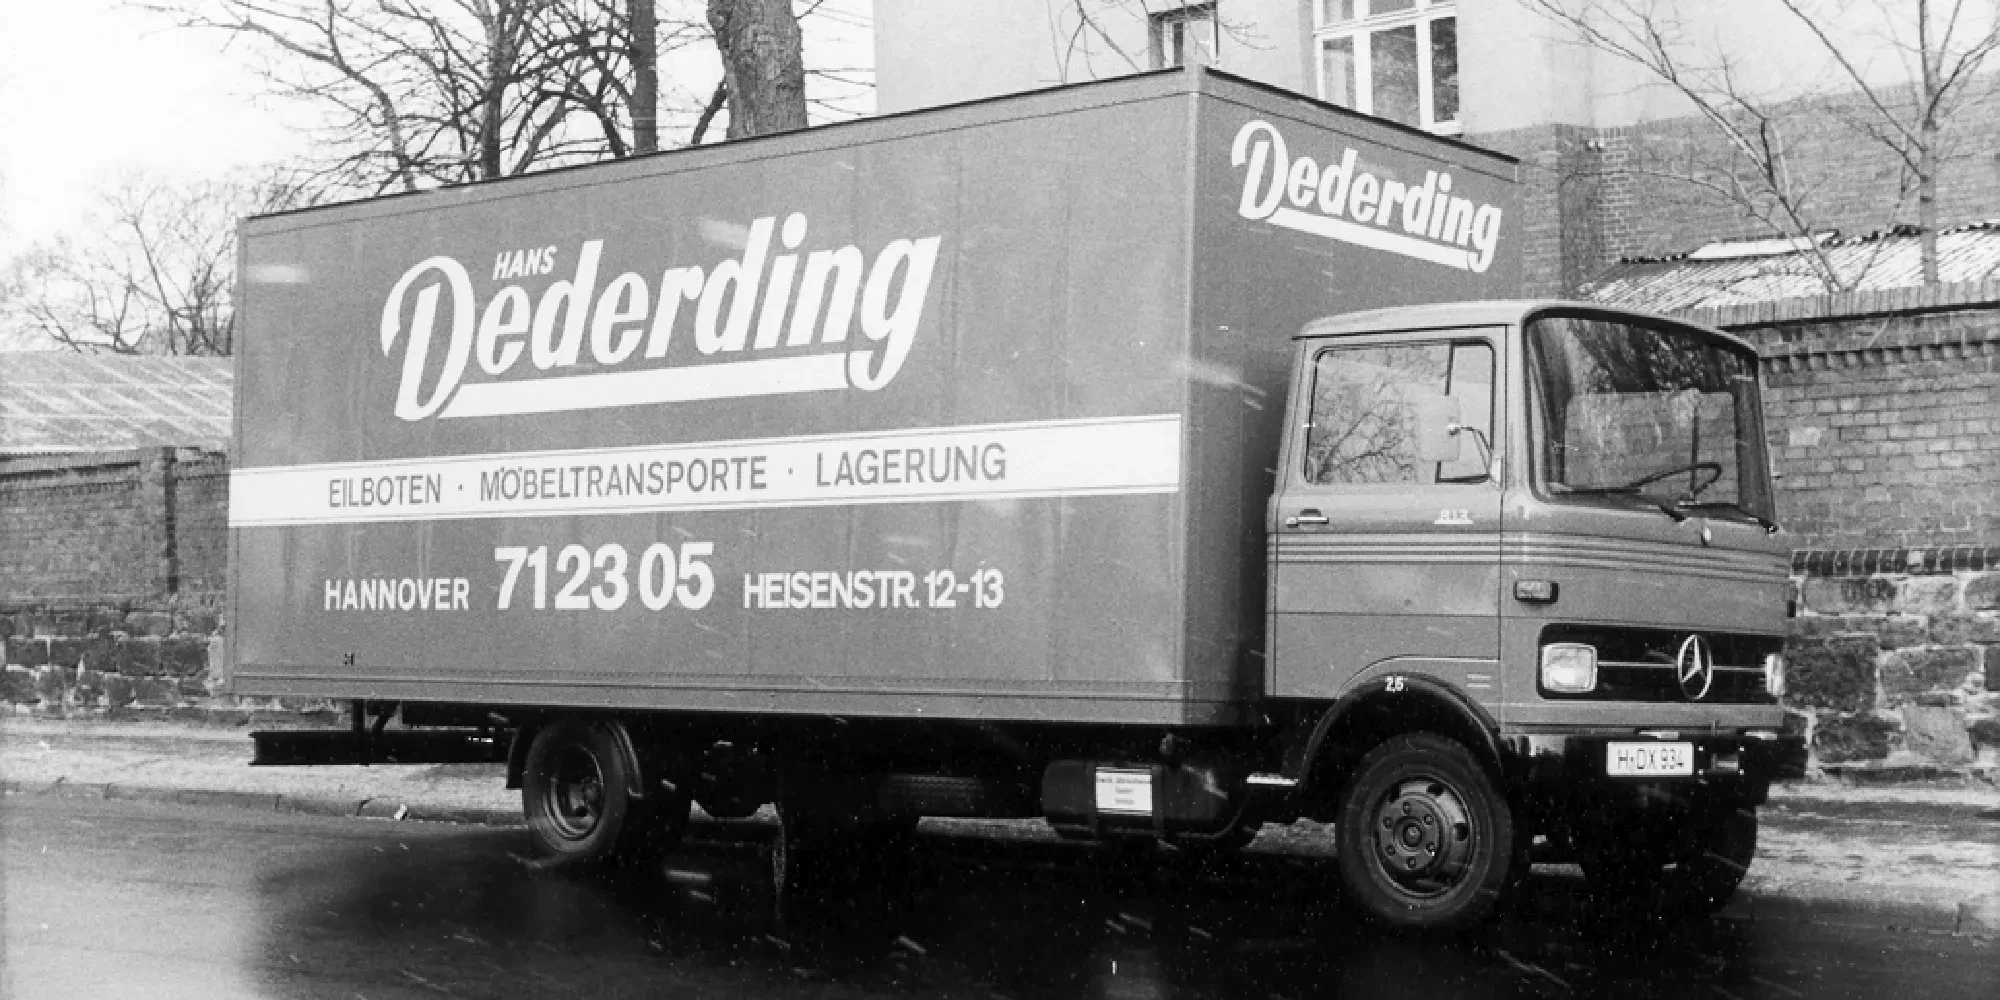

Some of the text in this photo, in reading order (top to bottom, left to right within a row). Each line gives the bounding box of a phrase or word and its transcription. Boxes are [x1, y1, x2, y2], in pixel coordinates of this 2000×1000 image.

[1231, 119, 1502, 273] Dederding
[493, 244, 558, 280] HANS
[380, 211, 942, 421] Dederding
[329, 442, 1006, 507] EILBOTEN MÖBELTRANSPORTE LAGERUNG
[324, 577, 470, 611] HANNOVER
[743, 568, 920, 609] HEISENSTR.
[923, 568, 1004, 609] 12-13
[1661, 748, 1684, 769] 934
